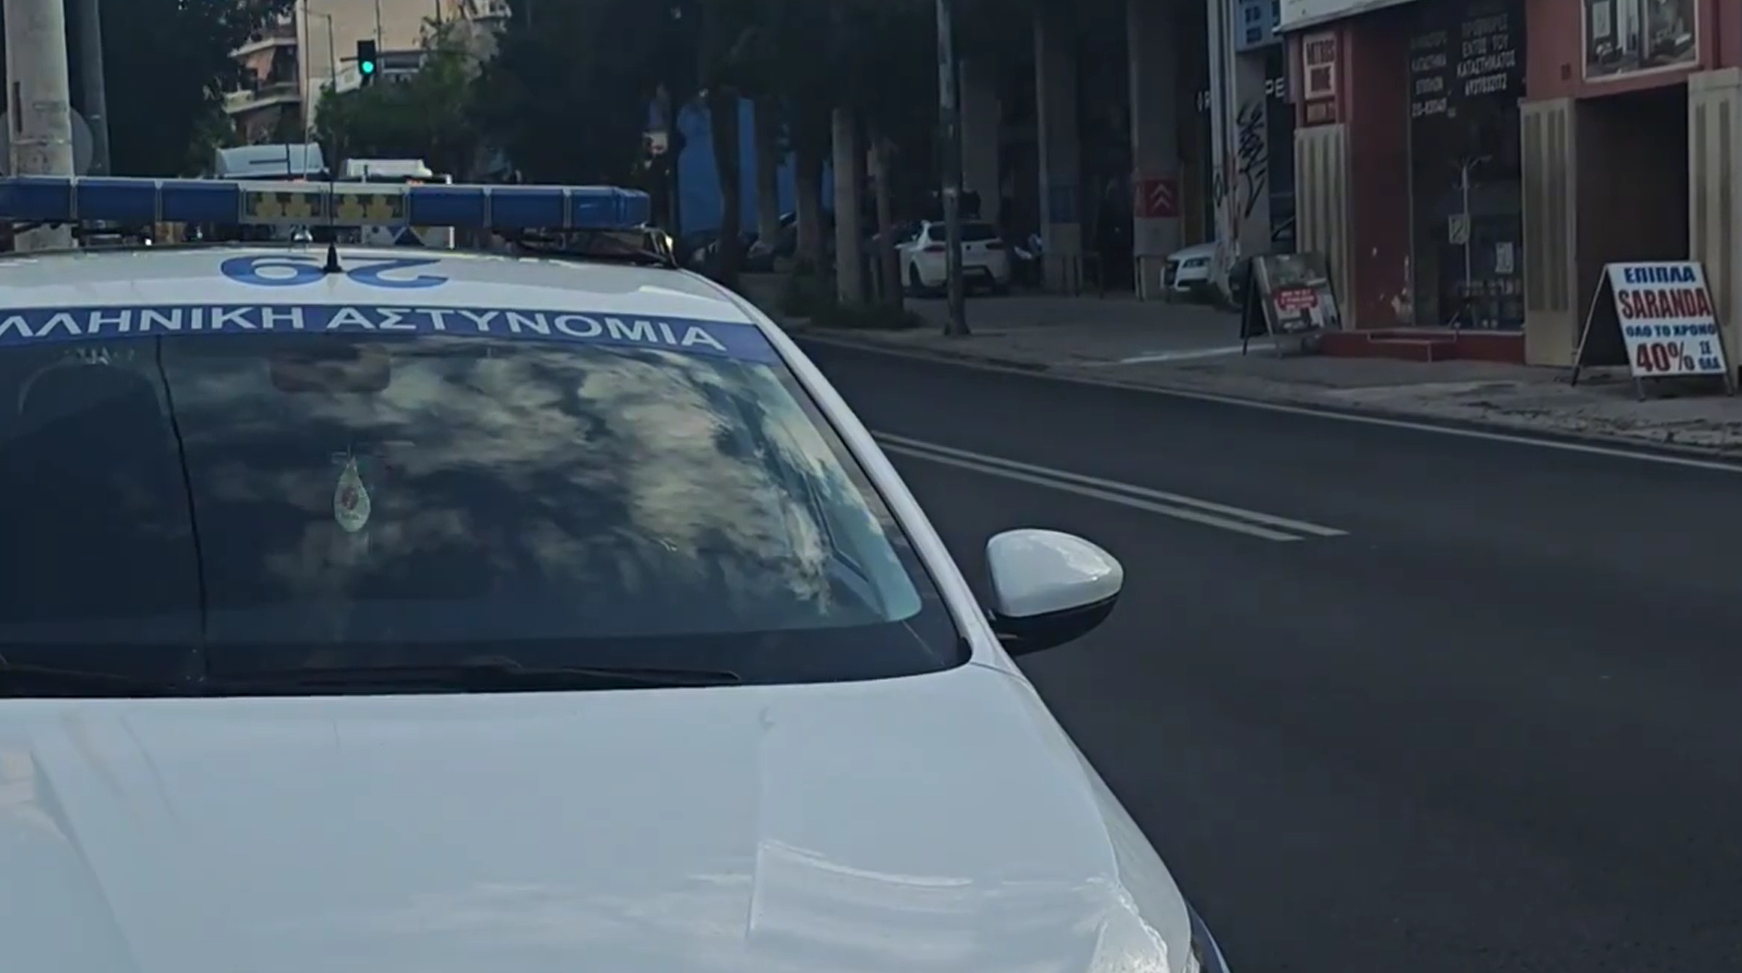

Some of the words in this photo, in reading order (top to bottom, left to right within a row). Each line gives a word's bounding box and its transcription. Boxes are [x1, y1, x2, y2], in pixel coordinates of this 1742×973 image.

[221, 255, 449, 288] 29
[1624, 266, 1696, 284] ΕΠΙΠΛΑ
[1618, 287, 1712, 319] SARANDA
[326, 308, 727, 351] ΑΣΤΥΝΟΜΙΑ
[1653, 325, 1671, 337] ΤΟ
[1672, 323, 1717, 337] ΧΡΟΝΟ
[1636, 341, 1695, 372] 40%
